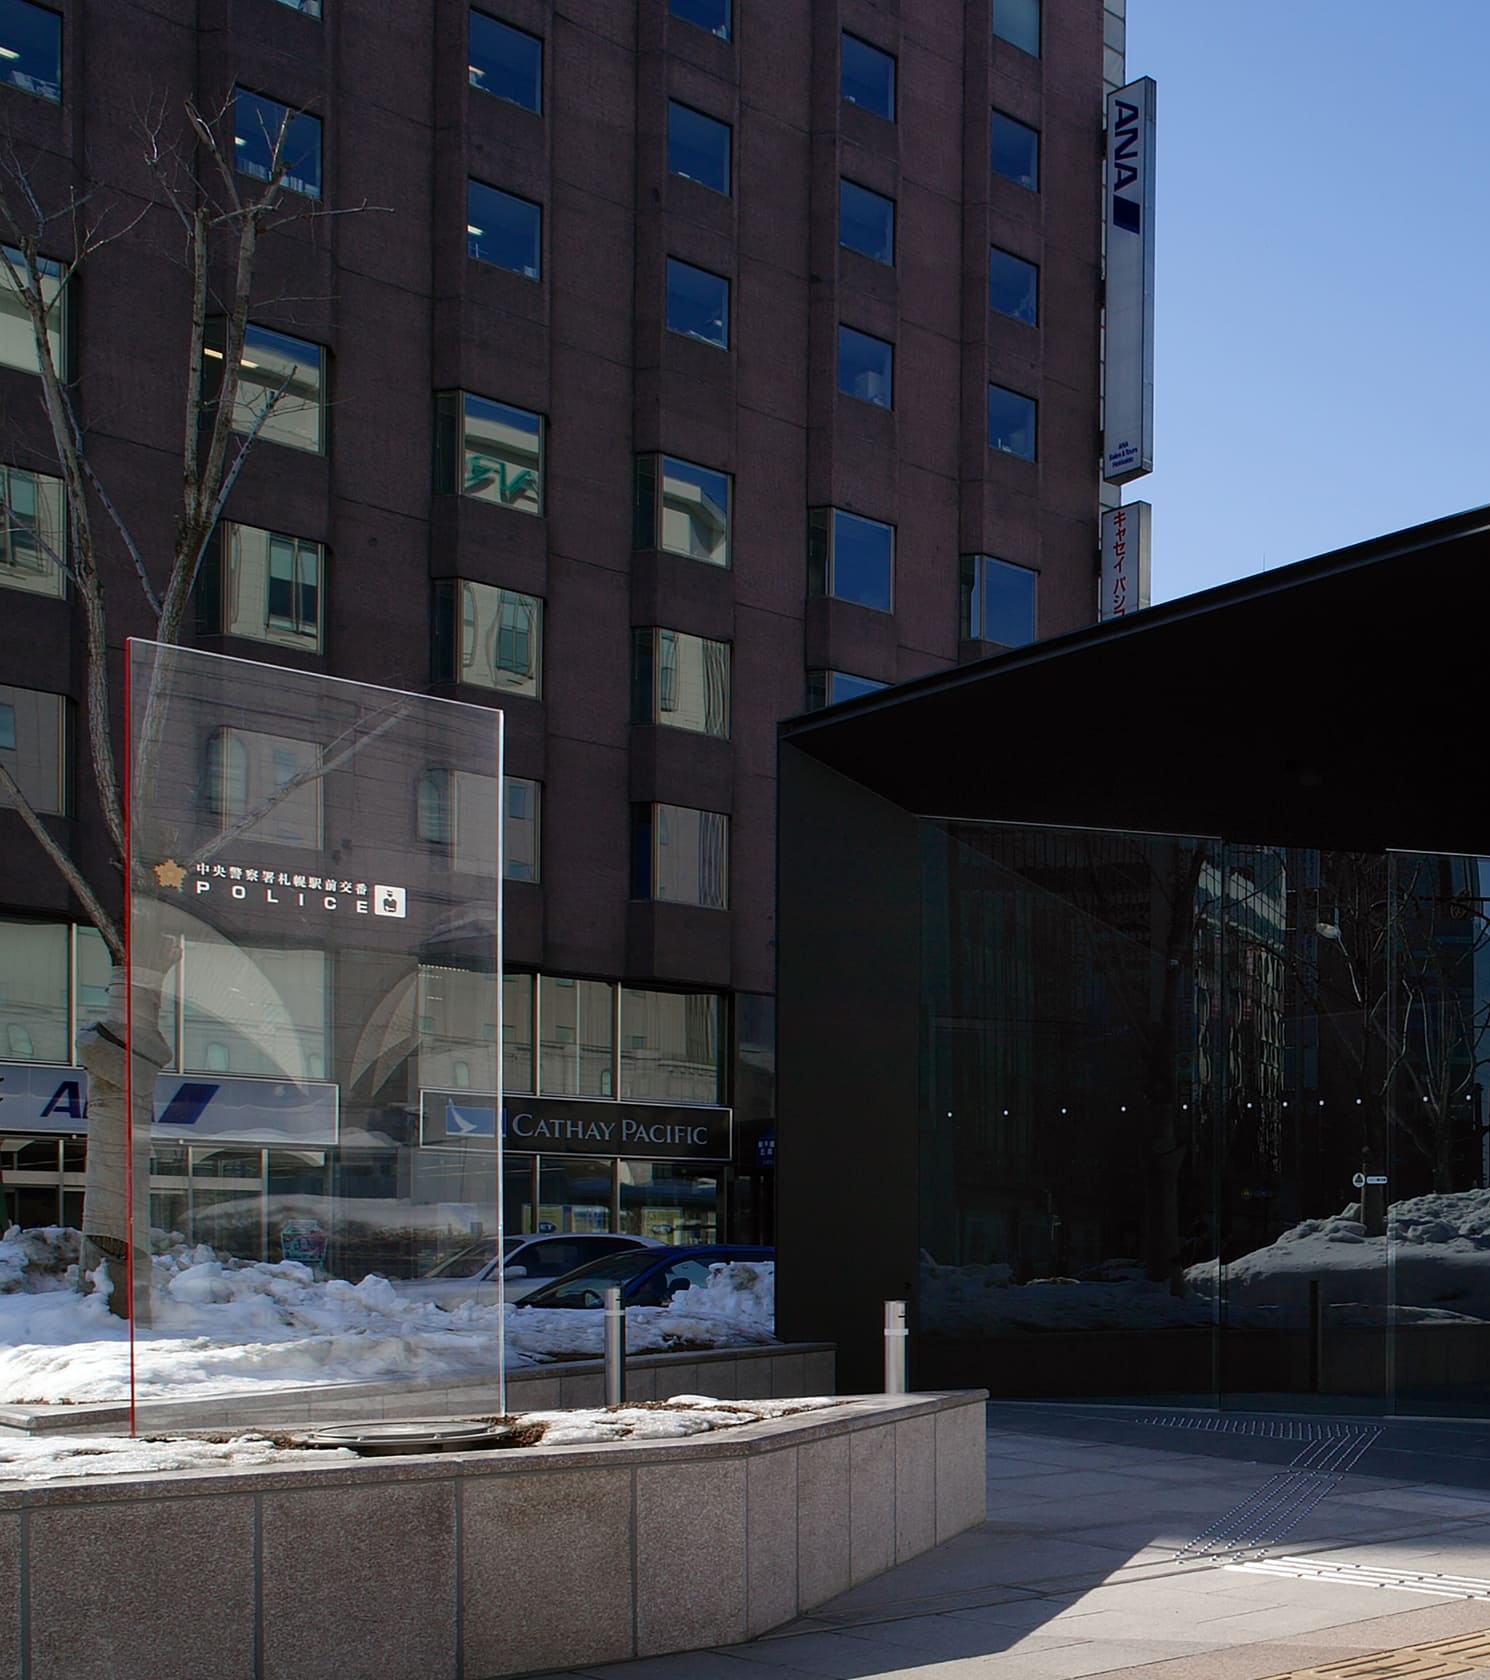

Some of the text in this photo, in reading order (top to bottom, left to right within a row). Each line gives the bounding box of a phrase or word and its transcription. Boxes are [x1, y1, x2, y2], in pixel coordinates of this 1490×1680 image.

[1113, 99, 1140, 193] ANA
[195, 862, 369, 897] 中央警察署札幌駅前交番
[195, 880, 369, 914] POLICE
[512, 1112, 709, 1146] CATHAY PACIFIC
